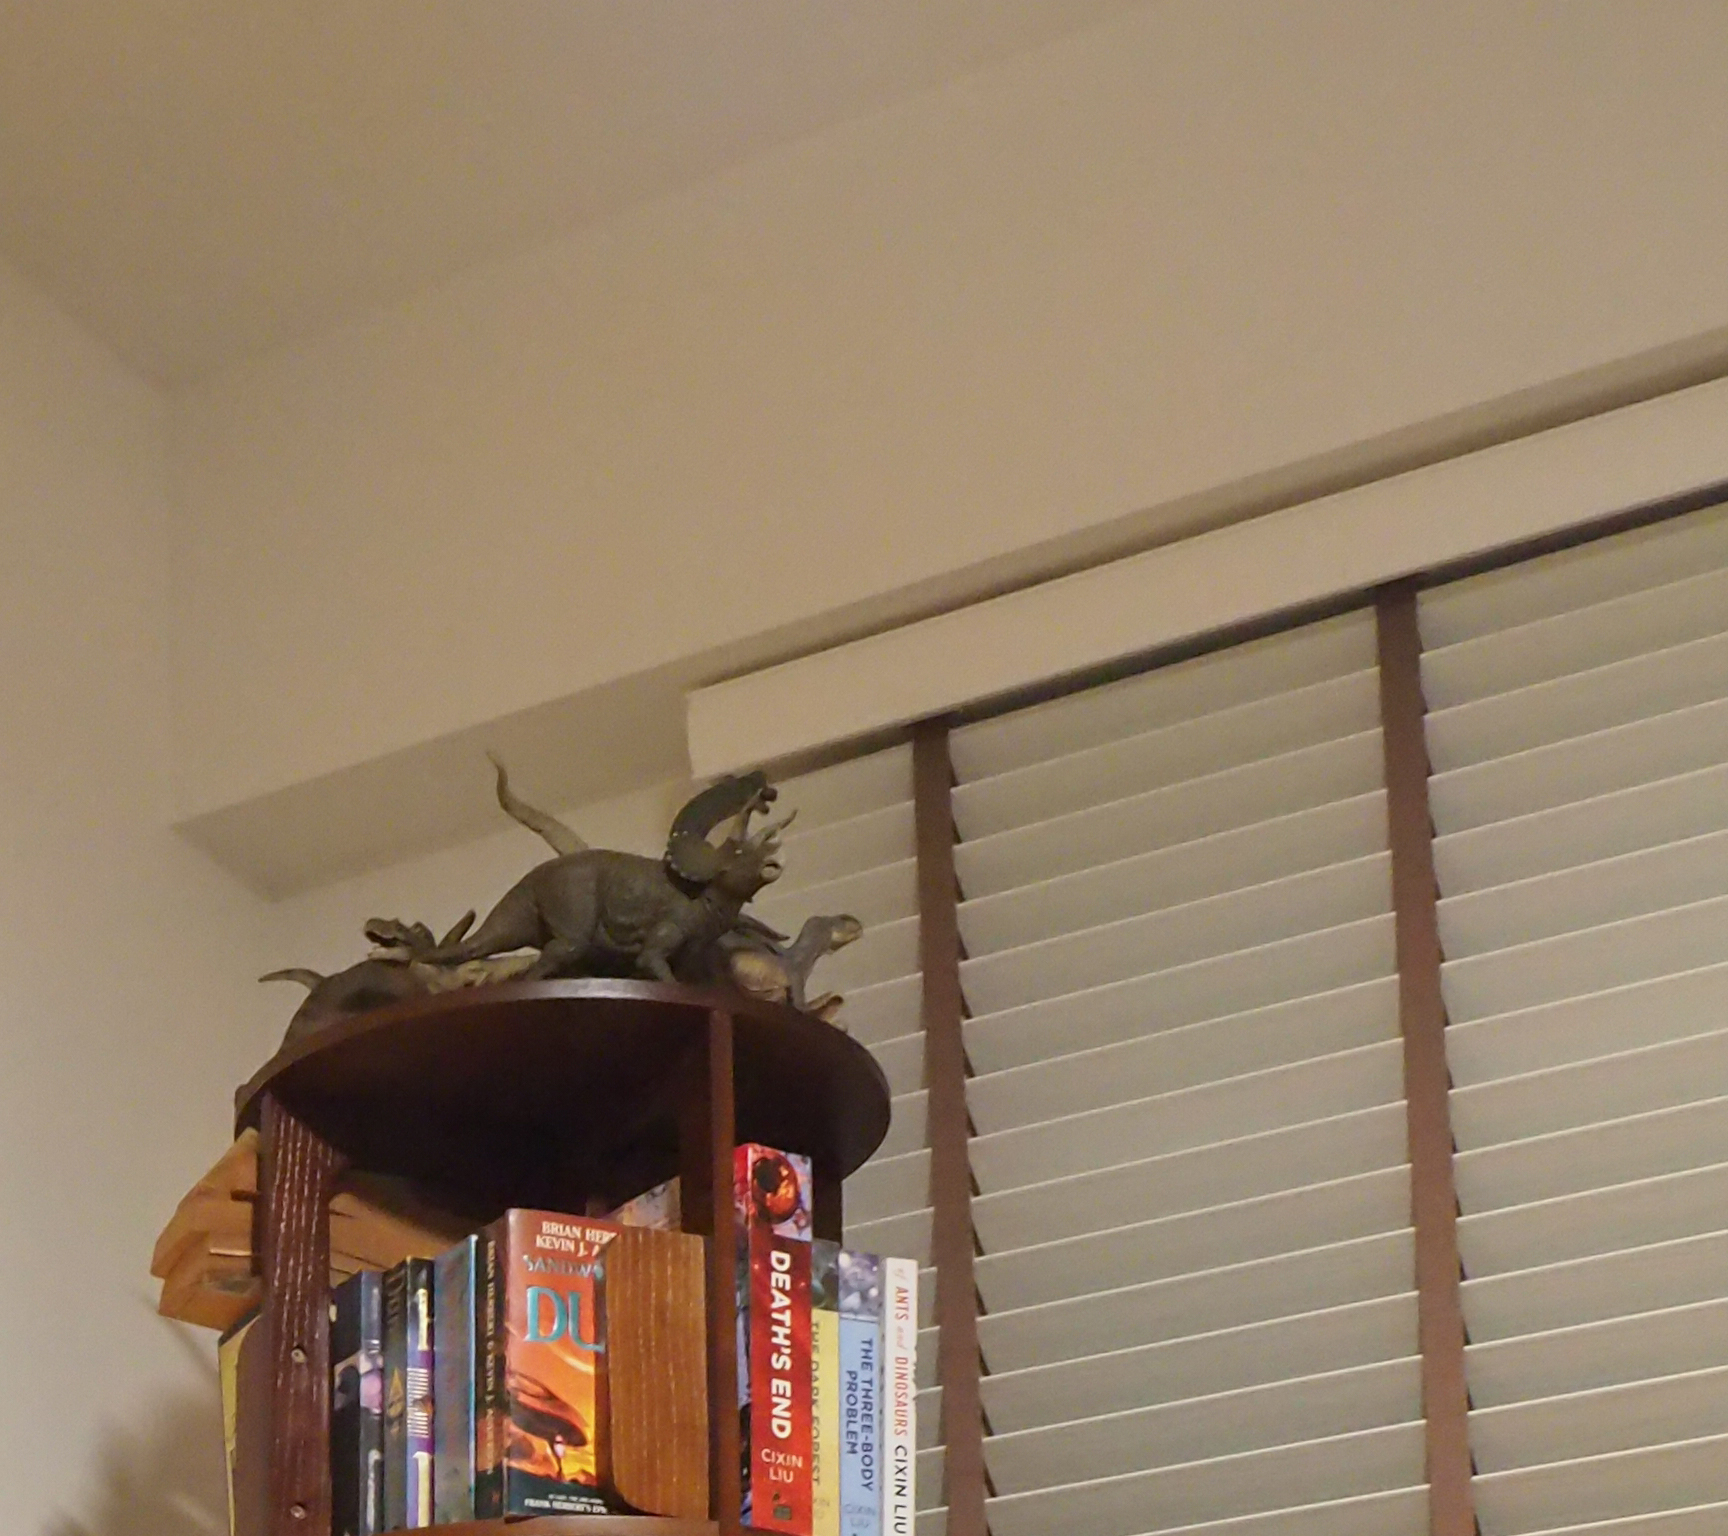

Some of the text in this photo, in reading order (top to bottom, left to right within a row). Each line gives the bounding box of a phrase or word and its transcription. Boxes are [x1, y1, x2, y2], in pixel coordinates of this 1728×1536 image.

[536, 1234, 575, 1252] KEVIN
[577, 1241, 588, 1257] J.
[542, 1221, 582, 1239] BRIAN
[894, 1286, 909, 1321] ANTS
[771, 1250, 792, 1439] DEATH'S END
[811, 1322, 820, 1357] THE
[846, 1370, 859, 1454] PROBLEM
[894, 1356, 909, 1437] DINOSAURS
[860, 1338, 874, 1491] THE THREE-BODY
[760, 1448, 803, 1468] CIXIN
[894, 1444, 908, 1497] CIXIN
[769, 1467, 794, 1483] LIU
[844, 1503, 876, 1516] CIXIN
[849, 1518, 870, 1529] LIU
[894, 1504, 907, 1534] LIU
